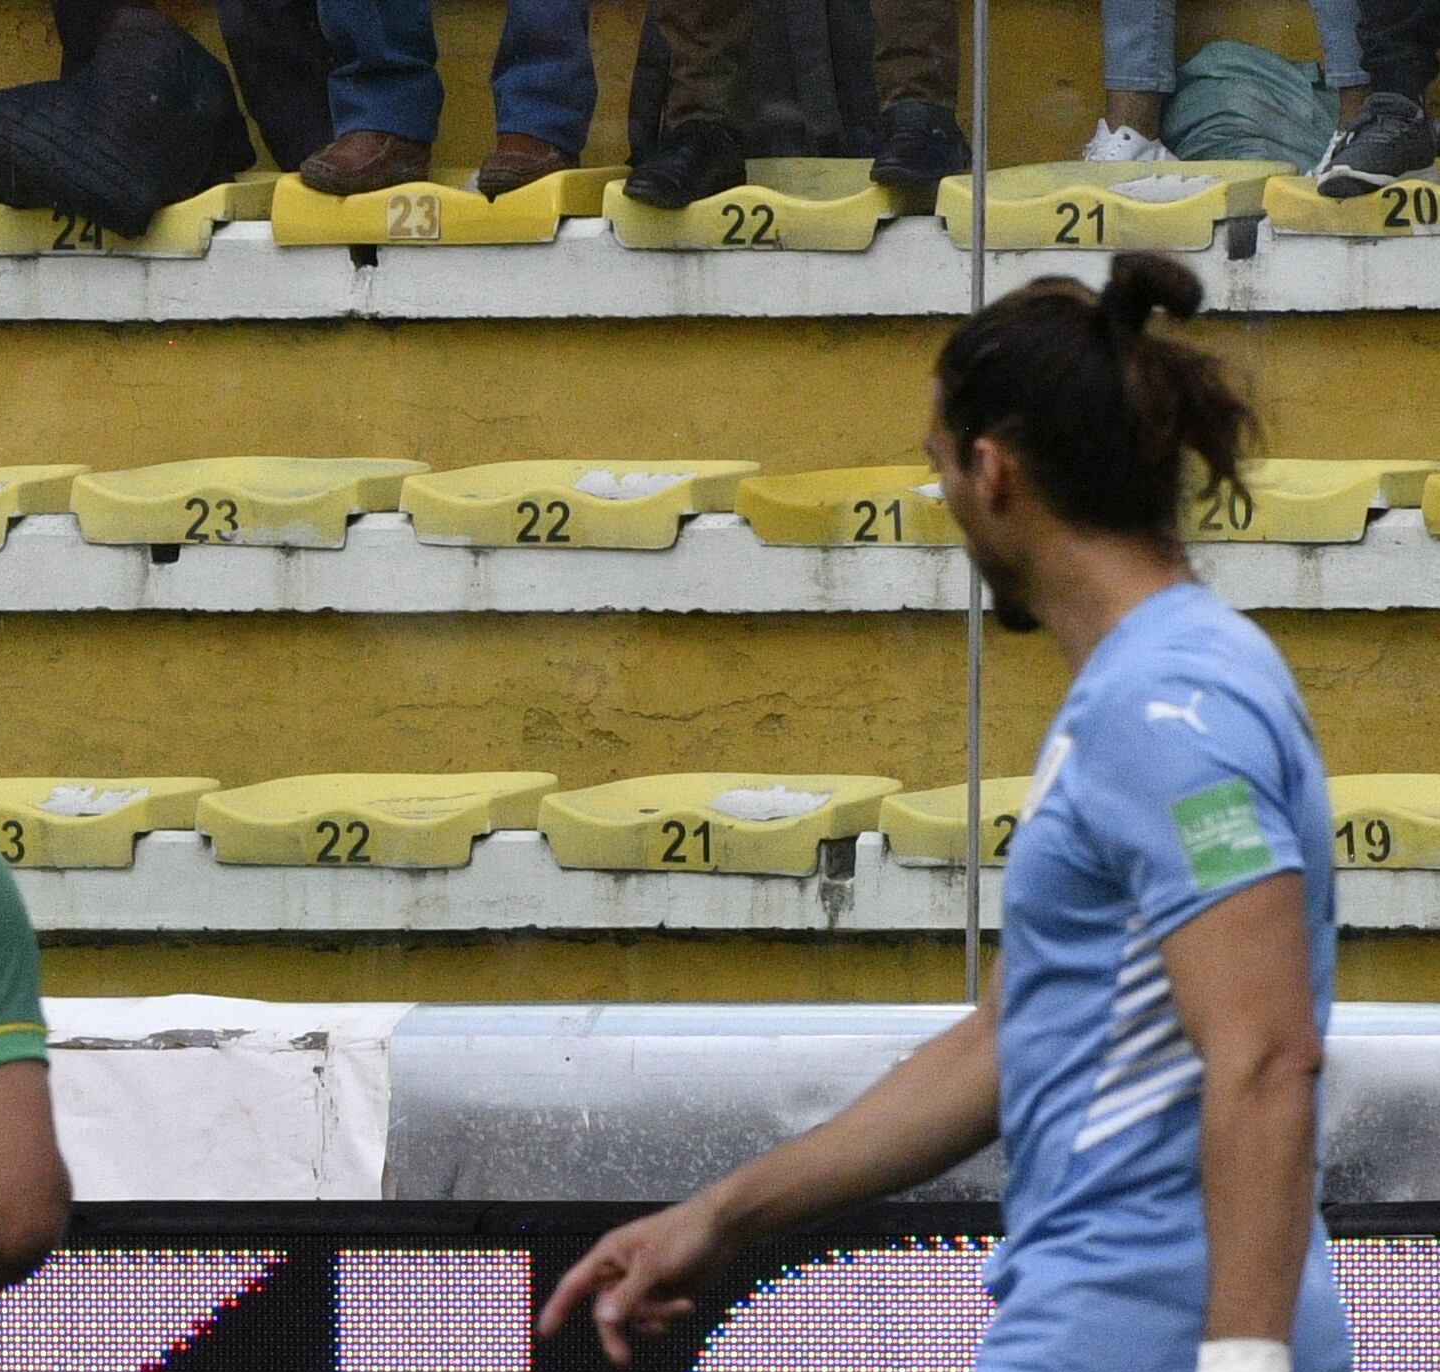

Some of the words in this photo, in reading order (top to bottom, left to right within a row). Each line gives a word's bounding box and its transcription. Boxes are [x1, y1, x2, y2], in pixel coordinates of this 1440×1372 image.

[388, 195, 440, 239] 23
[722, 204, 775, 245] 22
[1055, 203, 1104, 244] 21
[1383, 184, 1439, 228] 20
[51, 209, 104, 251] 24
[185, 498, 238, 541] 23
[517, 501, 570, 543] 22
[854, 500, 902, 542] 21
[1200, 490, 1253, 531] 20
[316, 821, 370, 863] 22
[662, 821, 710, 863] 21
[1336, 820, 1390, 862] 19
